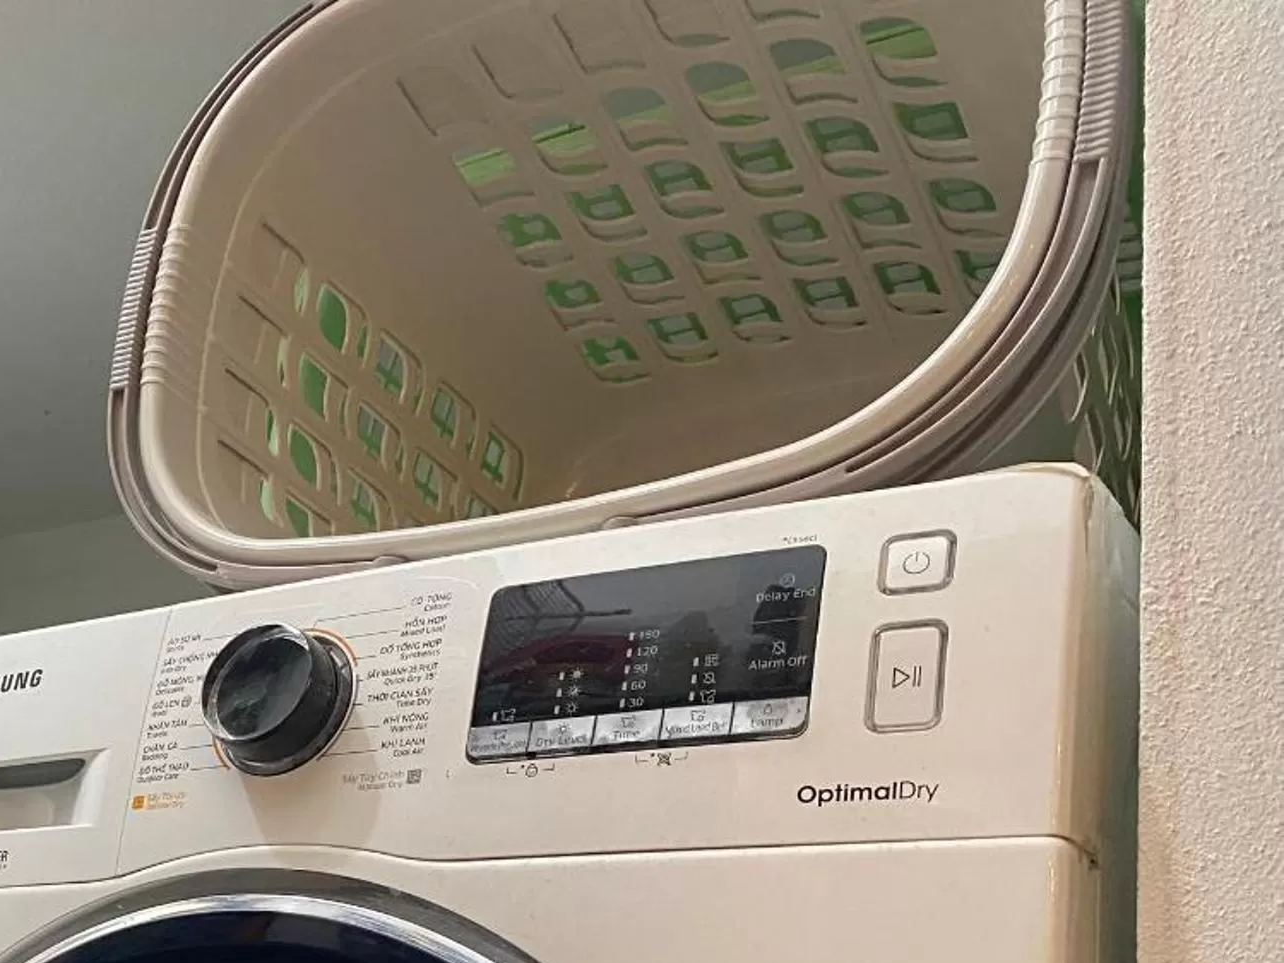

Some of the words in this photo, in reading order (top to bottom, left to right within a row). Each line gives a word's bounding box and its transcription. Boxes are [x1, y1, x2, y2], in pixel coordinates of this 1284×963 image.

[756, 588, 789, 602] Delay
[793, 586, 816, 598] End
[637, 645, 658, 656] 120
[633, 663, 648, 673] 90
[748, 656, 786, 671] Alarm
[788, 654, 808, 667] Off
[631, 680, 647, 691] 60
[628, 697, 644, 708] 30
[797, 780, 939, 807] OptimalDry
